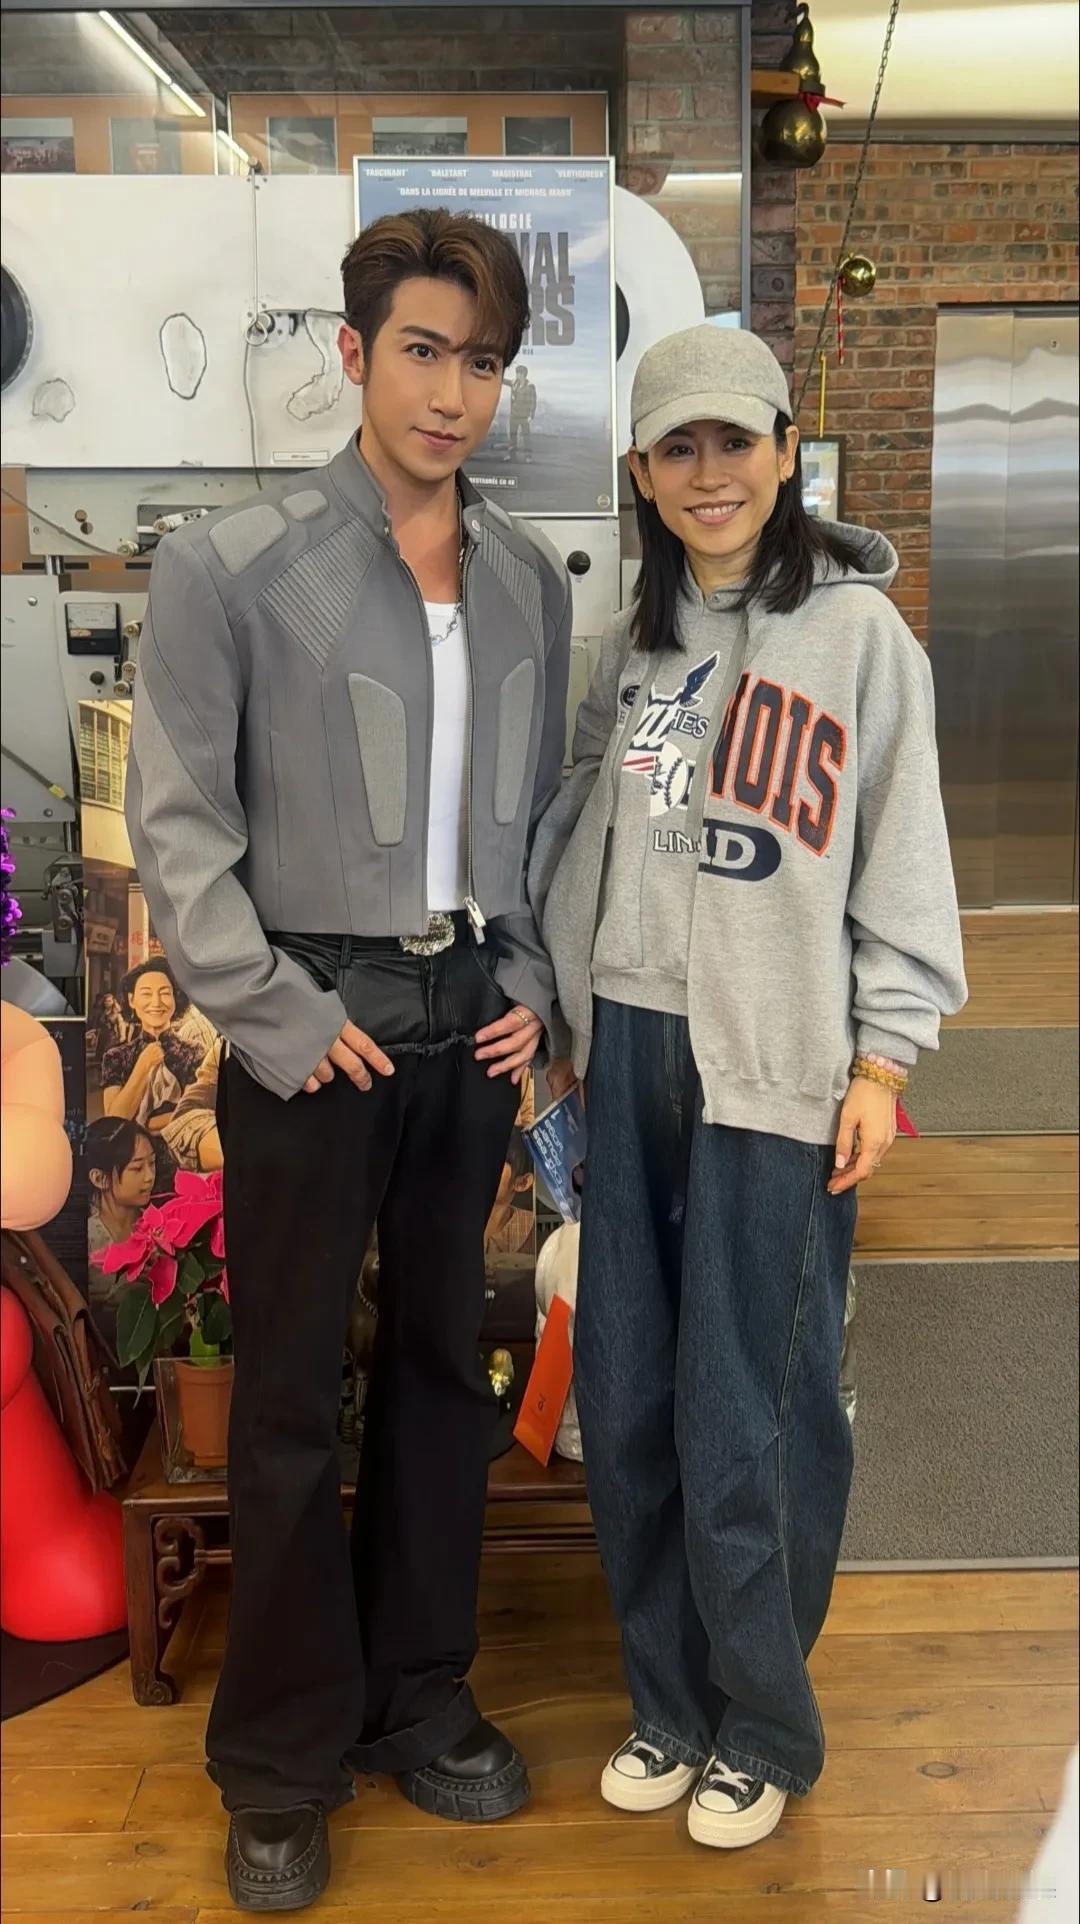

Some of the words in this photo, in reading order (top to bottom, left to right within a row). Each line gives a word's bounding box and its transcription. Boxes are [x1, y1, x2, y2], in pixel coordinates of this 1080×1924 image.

[421, 187, 431, 197] LA
[458, 187, 468, 197] DE
[504, 187, 513, 197] ET
[514, 187, 547, 198] MICHAEL
